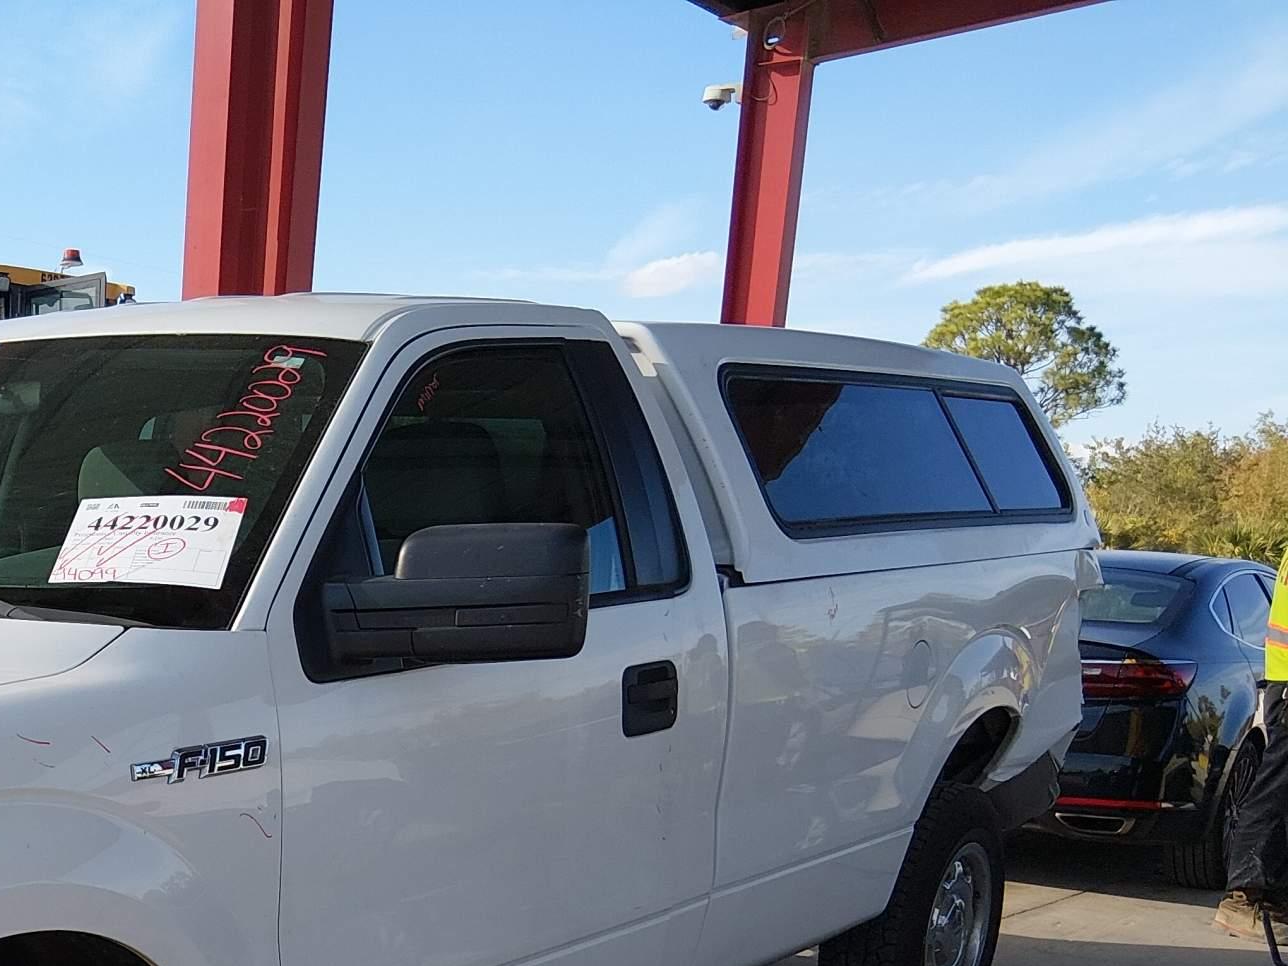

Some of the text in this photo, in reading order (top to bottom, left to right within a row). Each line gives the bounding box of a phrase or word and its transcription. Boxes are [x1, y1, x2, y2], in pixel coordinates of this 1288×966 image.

[164, 344, 328, 491] 44220029
[87, 514, 219, 532] 44220029
[169, 735, 268, 783] F-150
